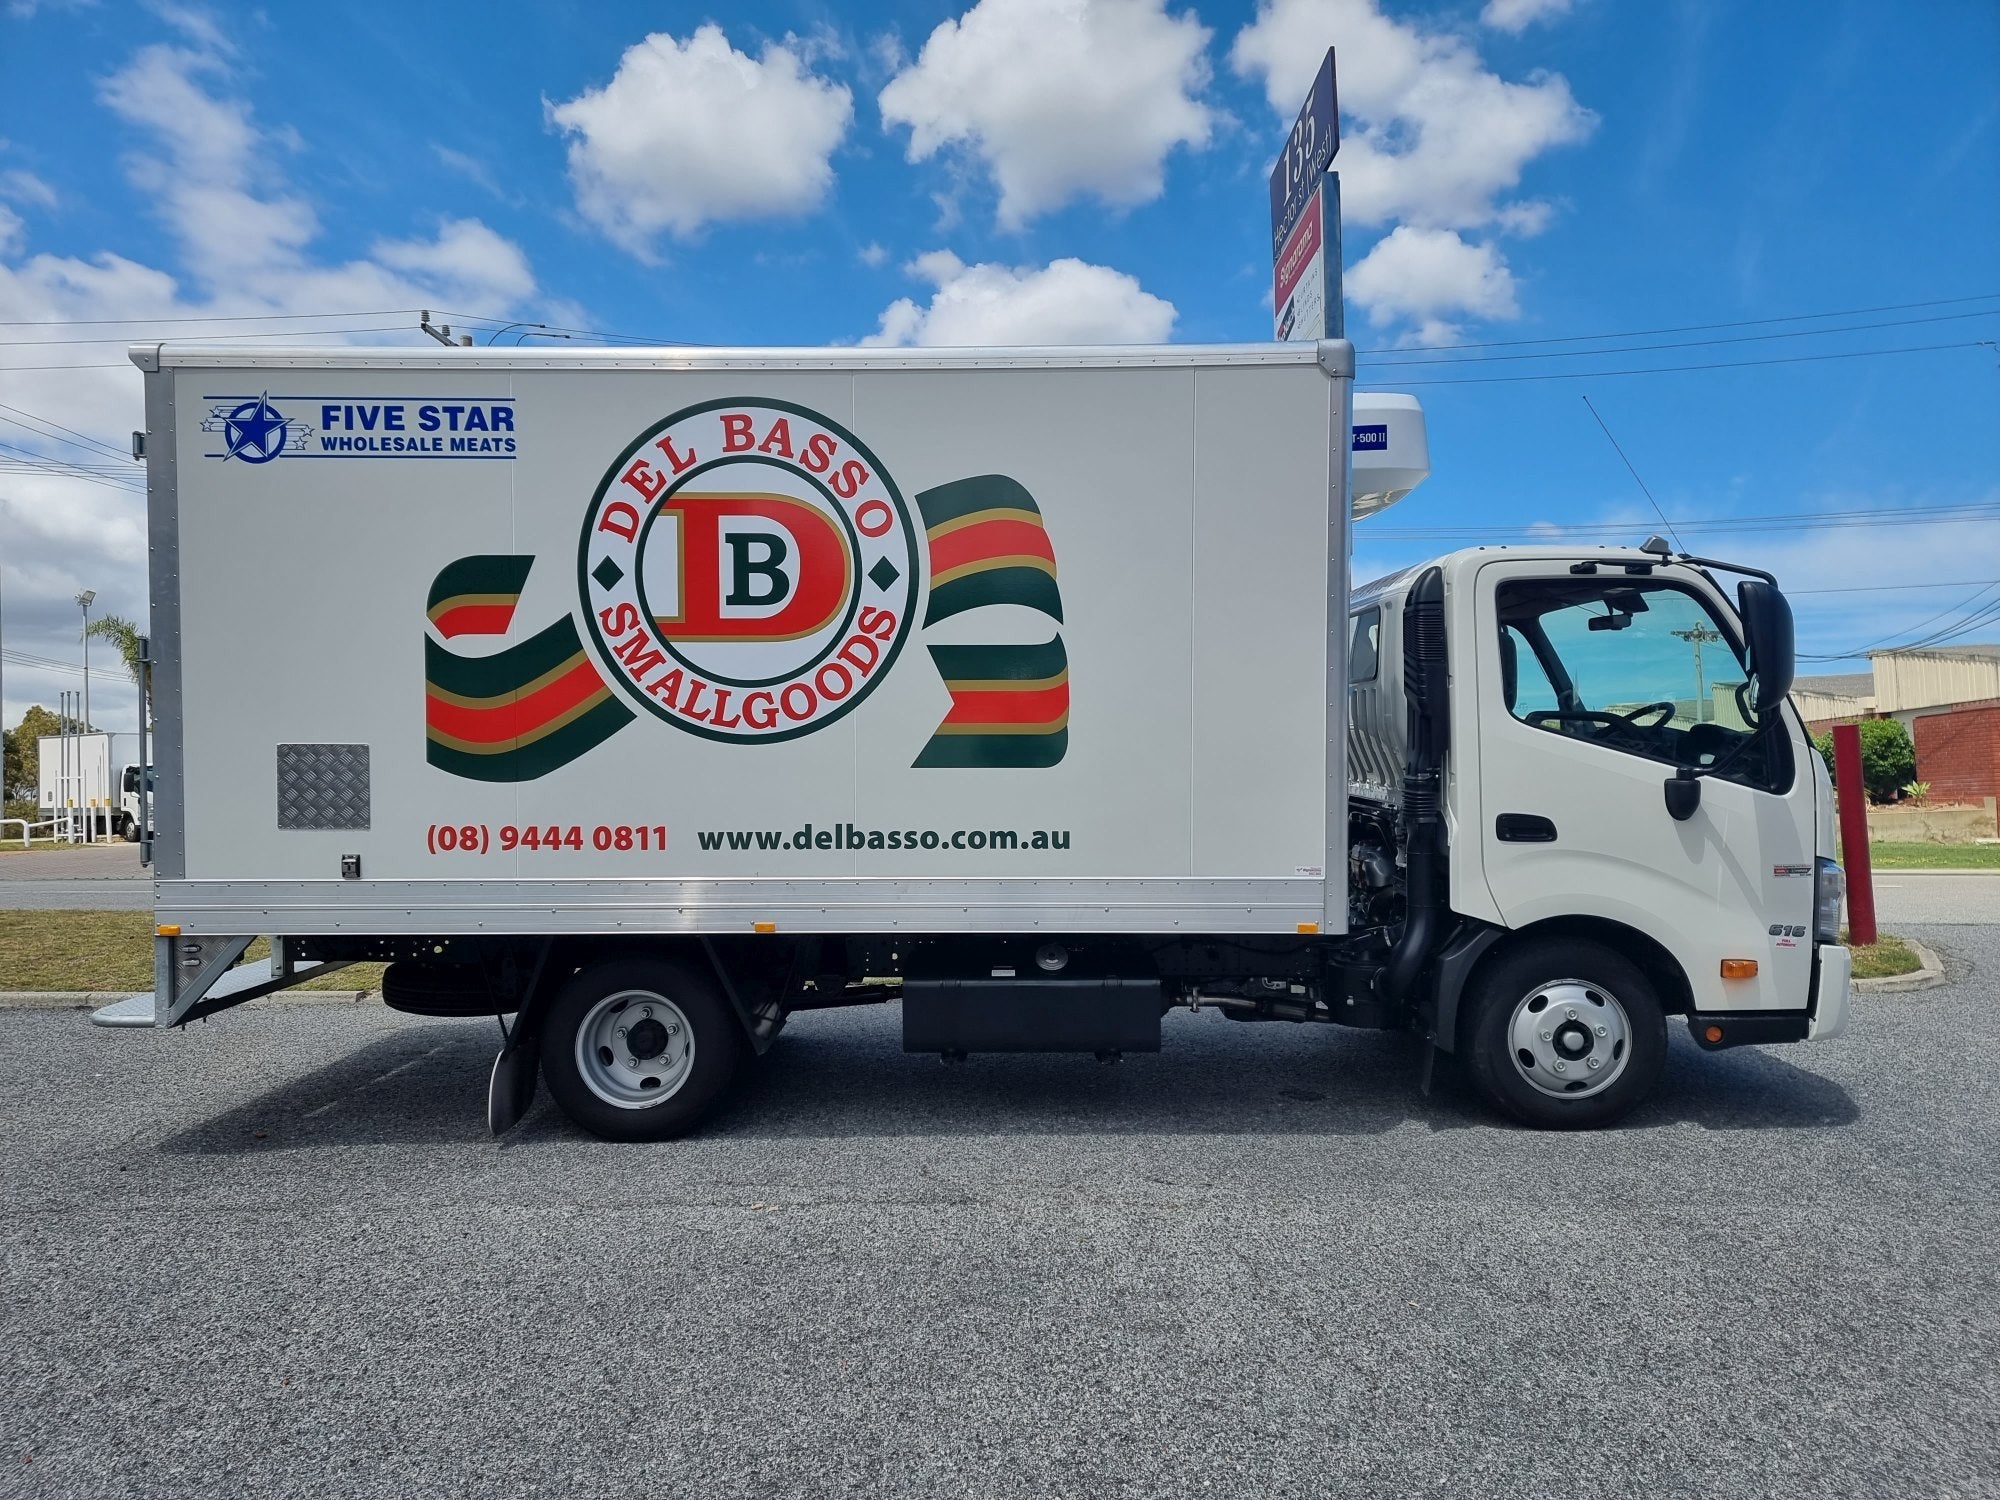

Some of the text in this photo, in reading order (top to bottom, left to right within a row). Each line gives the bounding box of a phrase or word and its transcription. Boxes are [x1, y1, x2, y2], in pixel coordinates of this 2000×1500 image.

[1283, 88, 1315, 206] 135
[1273, 196, 1297, 250] Hector
[1306, 124, 1332, 195] (West)
[321, 405, 515, 431] FIVE STAR
[321, 437, 516, 452] WHOLESALE MEATS
[598, 414, 893, 543] DEL BASSO
[724, 532, 790, 606] B
[599, 602, 896, 730] SMALLGOODS
[427, 825, 667, 856] (08) 9444 0811
[697, 823, 1071, 851] www.delbasso.com.au
[1769, 925, 1806, 937] 616
